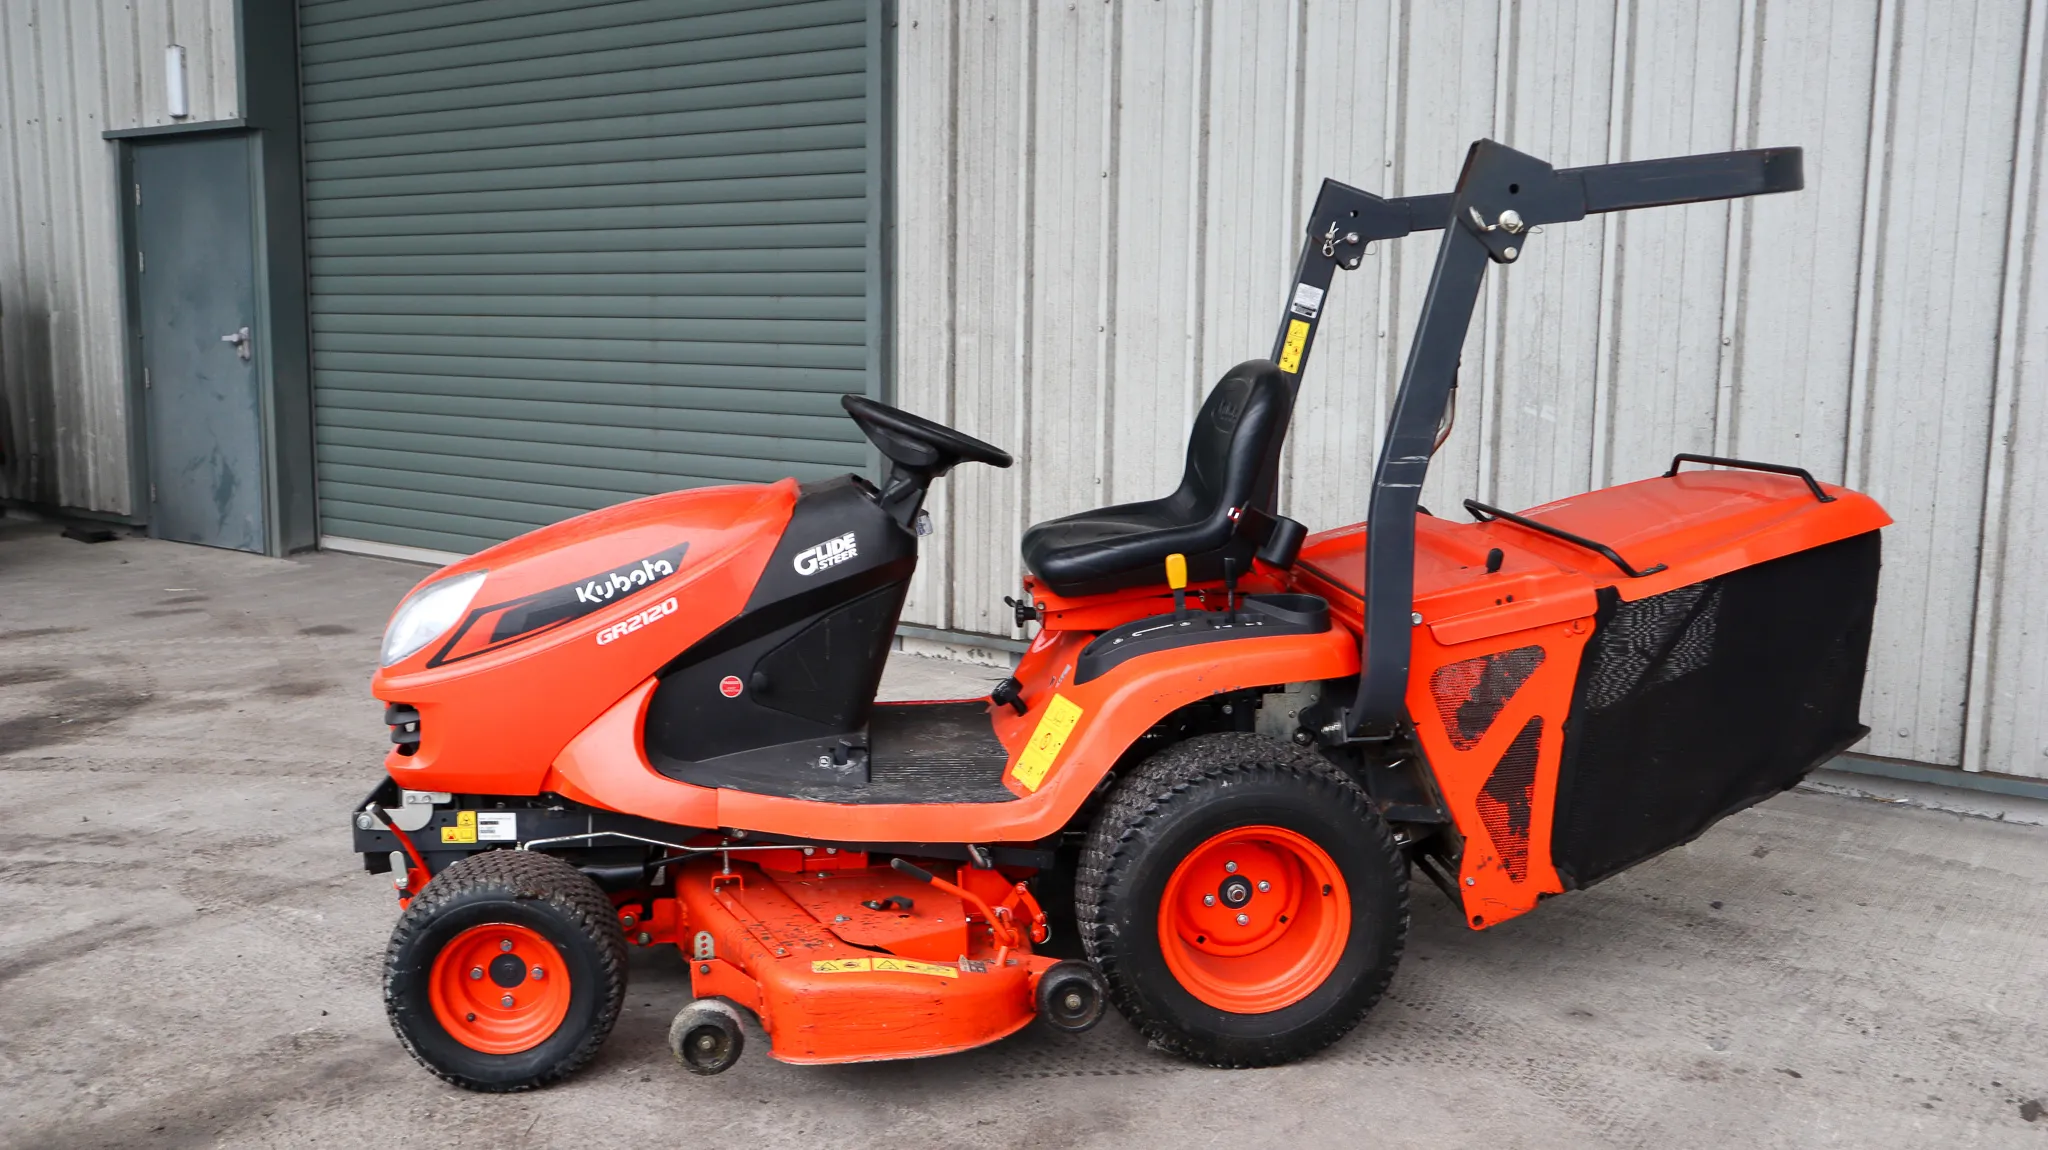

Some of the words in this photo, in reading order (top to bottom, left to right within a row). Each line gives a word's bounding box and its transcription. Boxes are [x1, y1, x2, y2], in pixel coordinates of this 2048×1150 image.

[793, 531, 857, 576] GLIDE
[818, 548, 858, 570] STEER
[575, 560, 674, 603] Kubota
[596, 597, 679, 645] GR2120
